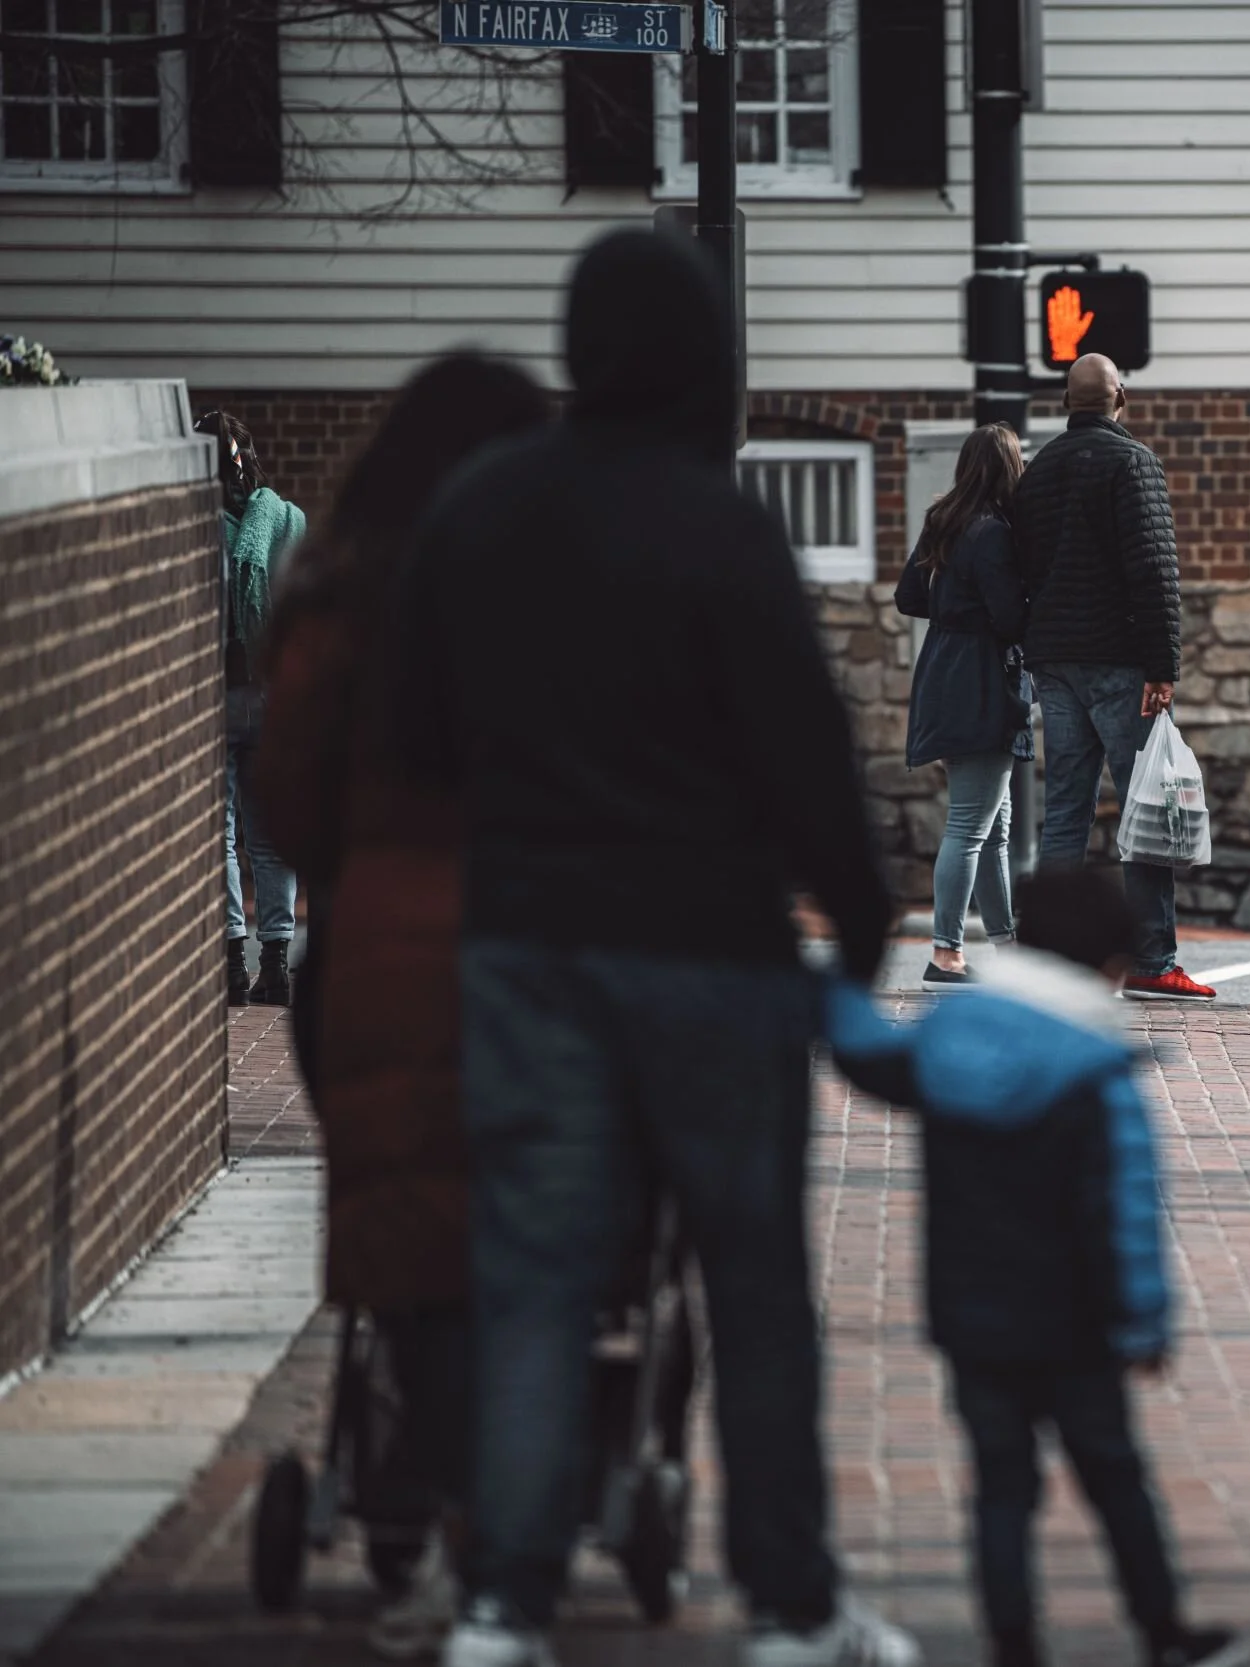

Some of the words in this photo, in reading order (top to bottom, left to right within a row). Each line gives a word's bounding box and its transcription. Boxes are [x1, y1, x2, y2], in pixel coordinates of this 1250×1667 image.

[454, 5, 467, 38] N
[479, 5, 569, 41] FAIRFAX
[644, 10, 666, 28] ST
[636, 28, 668, 46] 100
